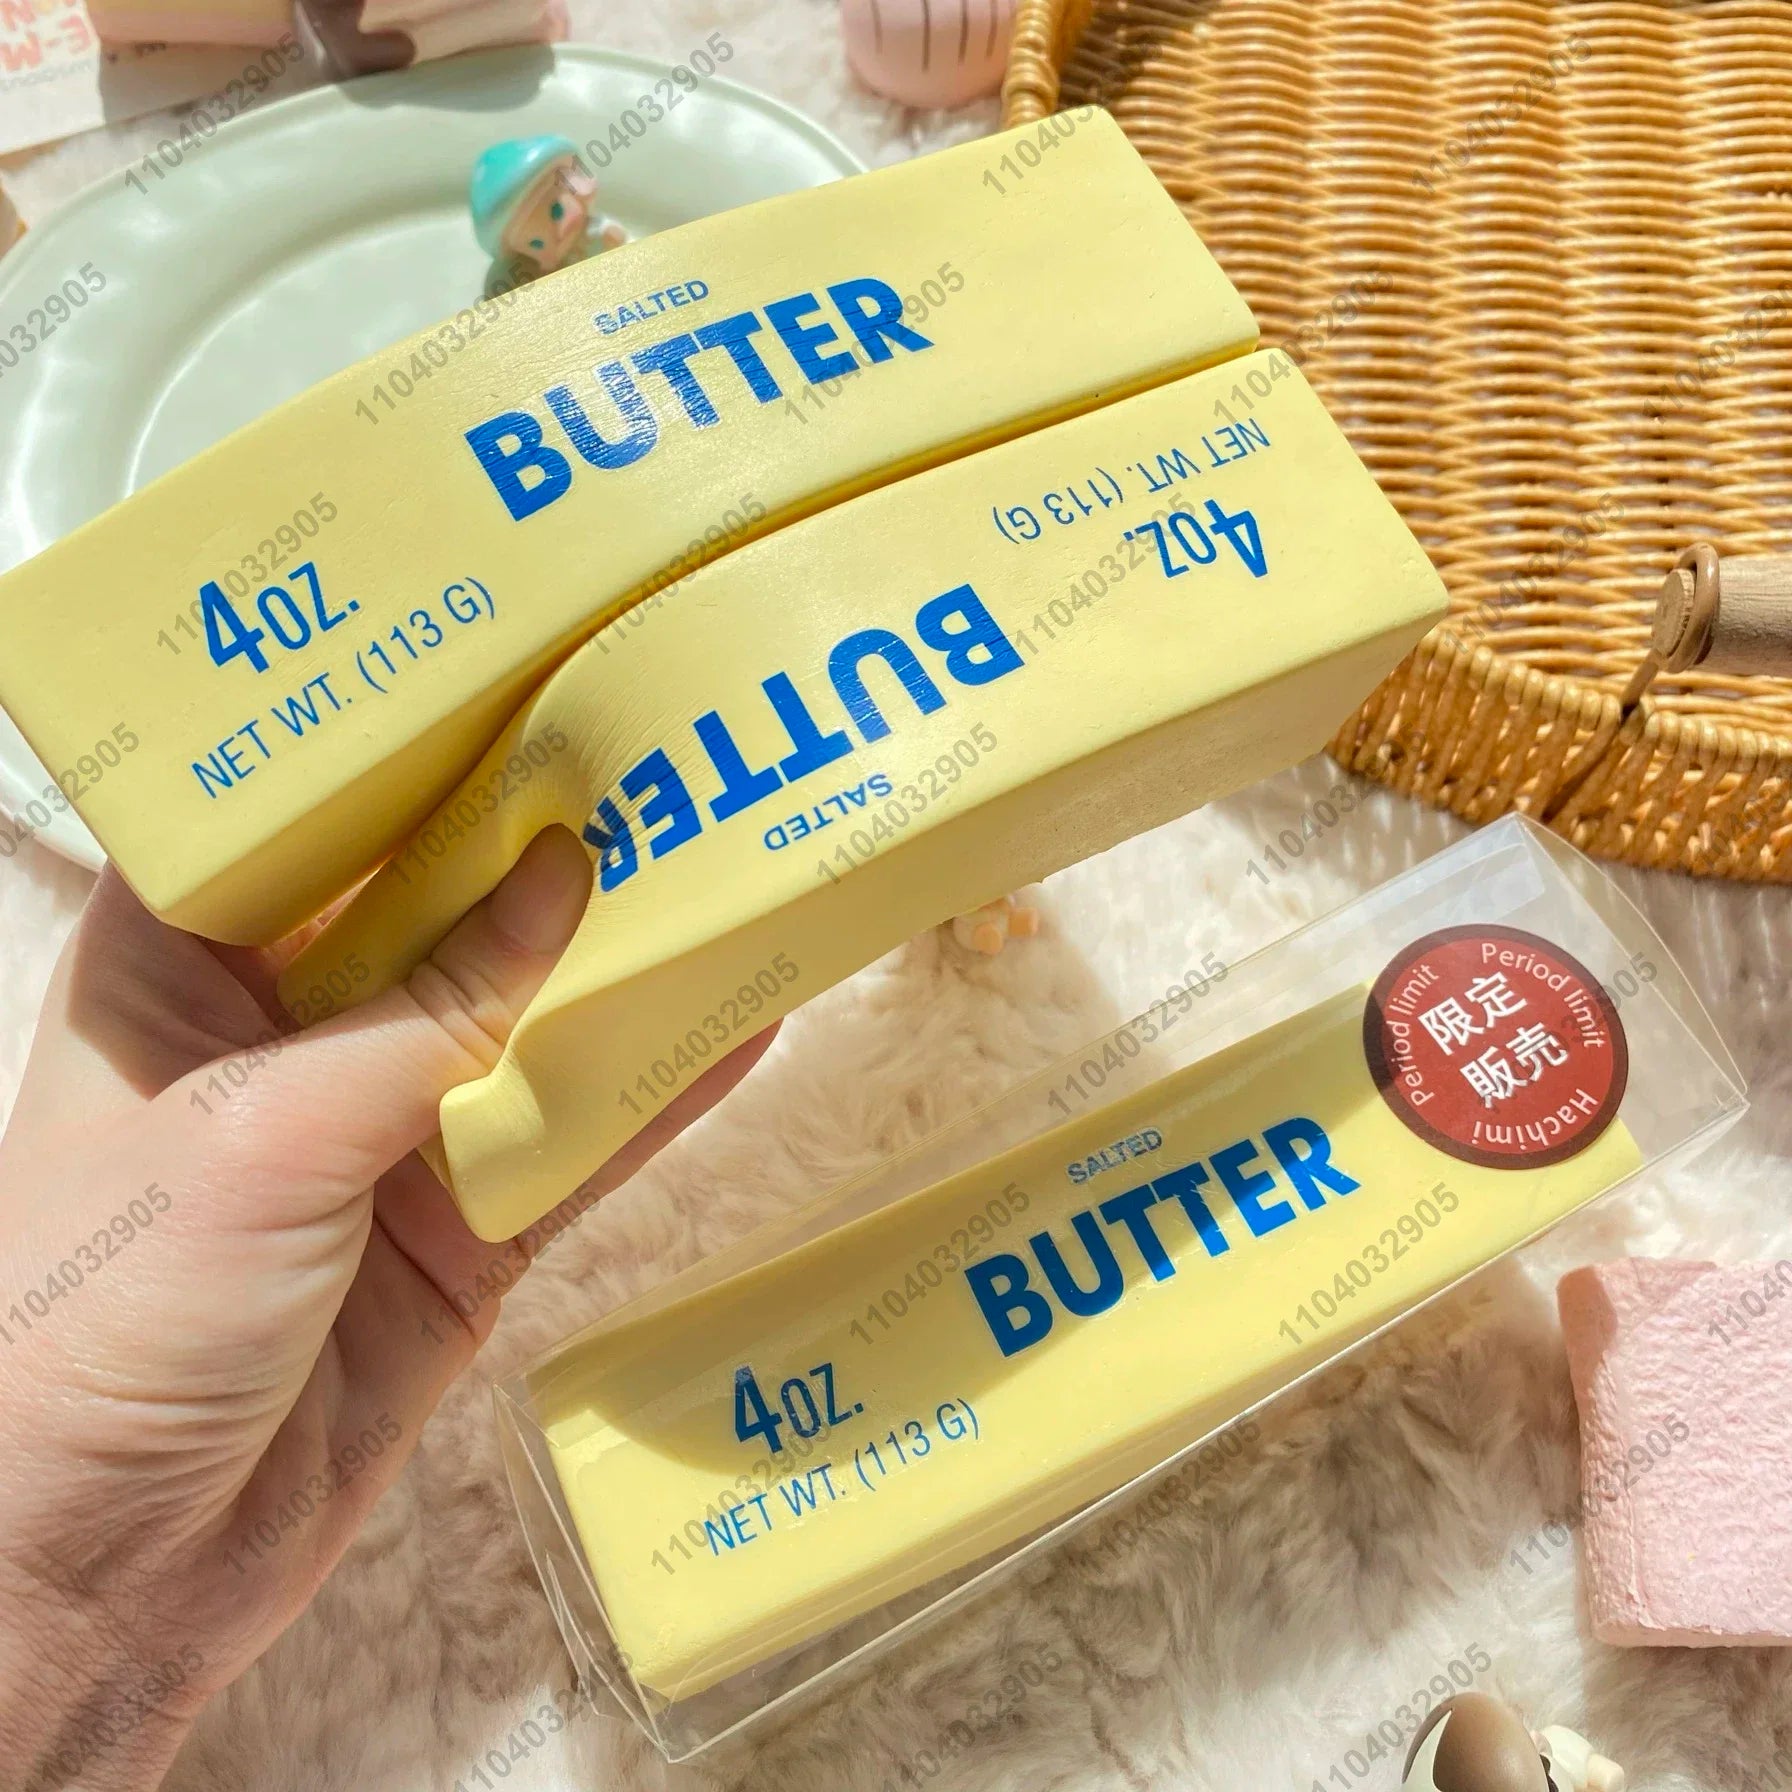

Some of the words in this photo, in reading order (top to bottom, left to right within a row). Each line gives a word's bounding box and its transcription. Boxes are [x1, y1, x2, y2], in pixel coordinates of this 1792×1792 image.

[592, 280, 710, 335] SALTED
[464, 277, 935, 522] BUTTER
[1126, 448, 1201, 493] WT.
[1201, 417, 1271, 468] NET
[993, 506, 1042, 545] G)
[1043, 467, 1124, 525] (113
[192, 719, 271, 798] NET
[271, 672, 352, 737] WT.
[356, 609, 443, 694] (113
[443, 577, 494, 624] G)
[582, 583, 1026, 893] BUTTER
[763, 773, 894, 850] SALTED
[1389, 964, 1439, 1015] limit
[1418, 971, 1528, 1056] 限定
[1481, 943, 1571, 992] Period
[1564, 989, 1607, 1048] limit
[1386, 1020, 1435, 1106] Period
[1459, 1022, 1568, 1108] 販売
[1066, 1127, 1163, 1185] SALTED
[1472, 1088, 1599, 1150] Hachimi
[964, 1117, 1361, 1358] BUTTER
[704, 1493, 772, 1556] NET
[778, 1463, 846, 1517] WT.
[854, 1421, 931, 1492] (113
[936, 1398, 979, 1440] G)
